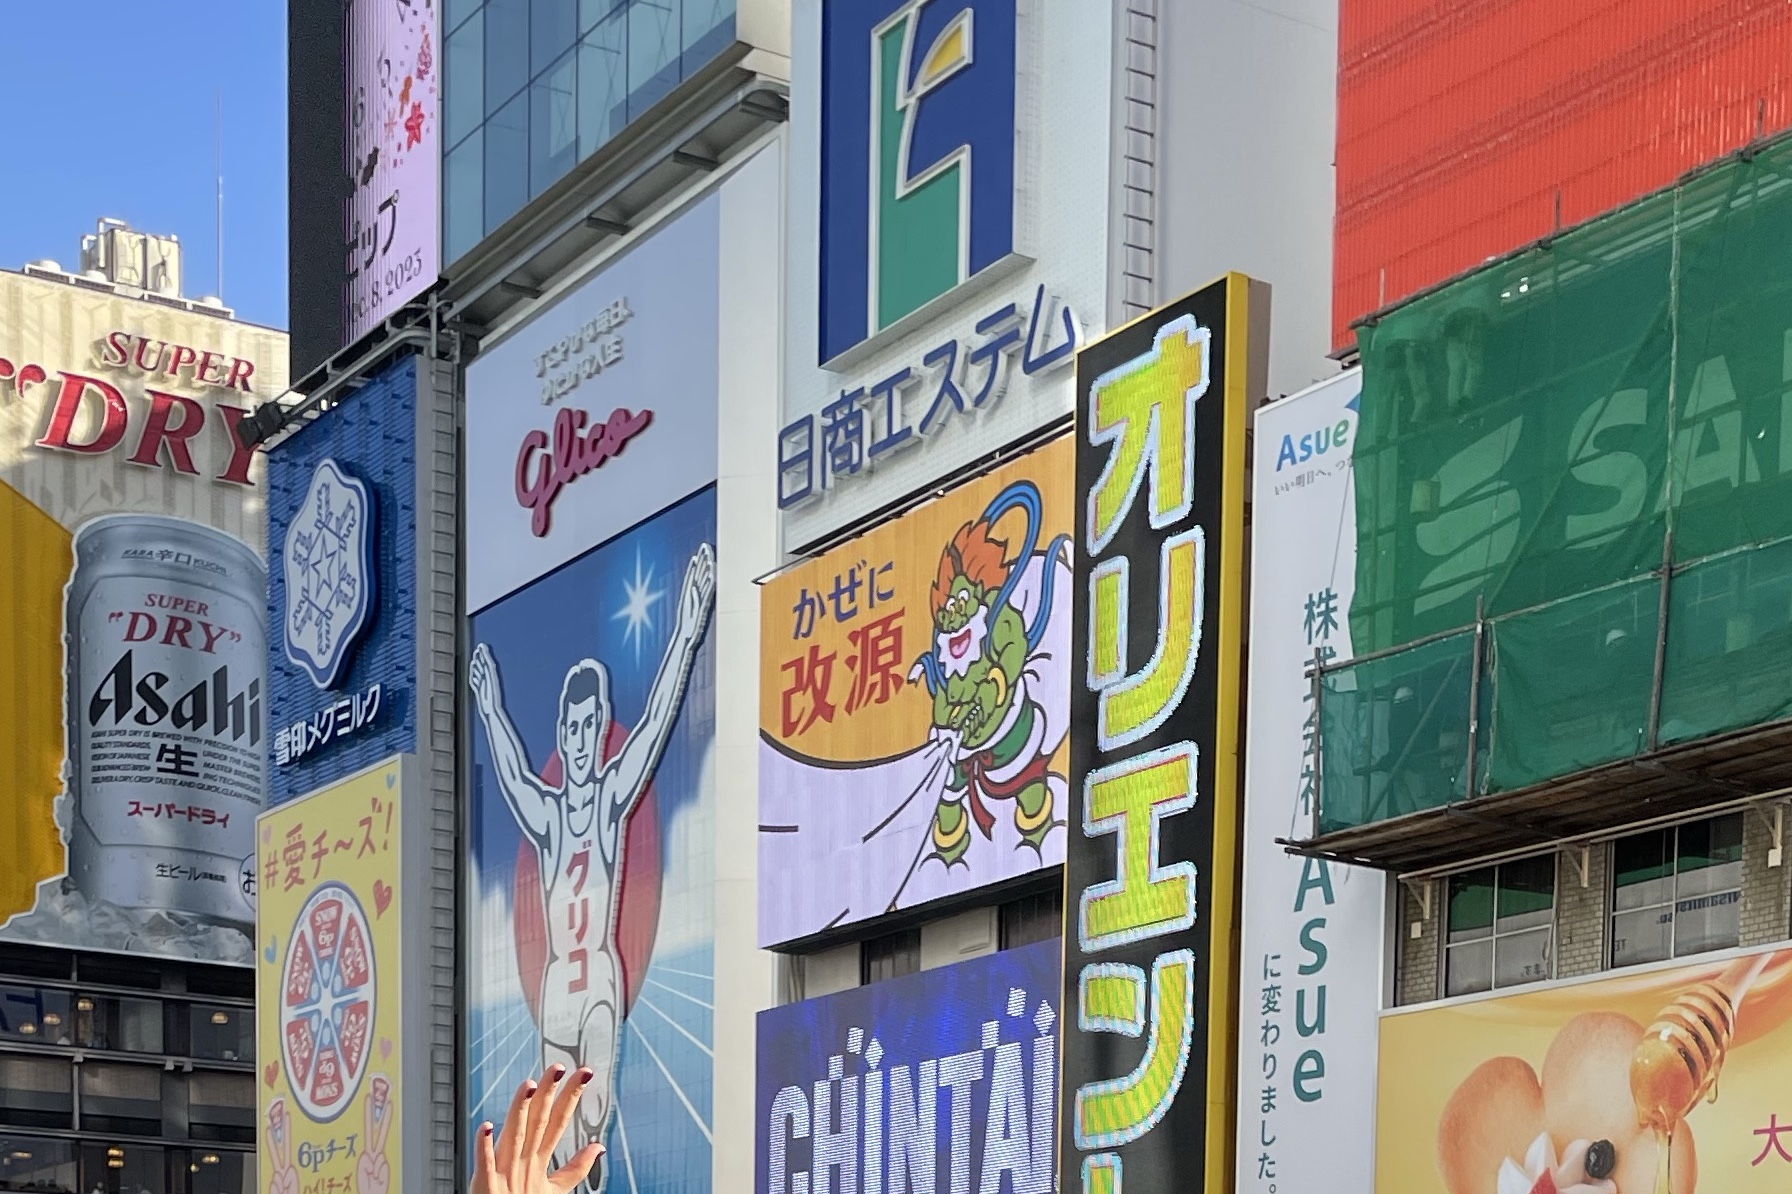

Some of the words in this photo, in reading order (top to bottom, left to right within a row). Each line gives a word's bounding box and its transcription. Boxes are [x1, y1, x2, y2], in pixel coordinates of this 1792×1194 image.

[104, 331, 255, 392] SUPER
[779, 284, 1076, 510] 日商エステム
[515, 407, 653, 537] Glico
[1276, 419, 1349, 472] Asue
[1566, 328, 1792, 549] SA
[144, 593, 209, 617] SUPER
[793, 558, 895, 640] かぜに
[88, 648, 261, 748] Asahi
[780, 606, 906, 739] 改源
[156, 743, 199, 778] 生
[273, 683, 381, 767] 雪印メグミルク
[127, 801, 230, 829] スーパードライ
[156, 863, 203, 881] 生ビール
[566, 839, 592, 995] グリコ
